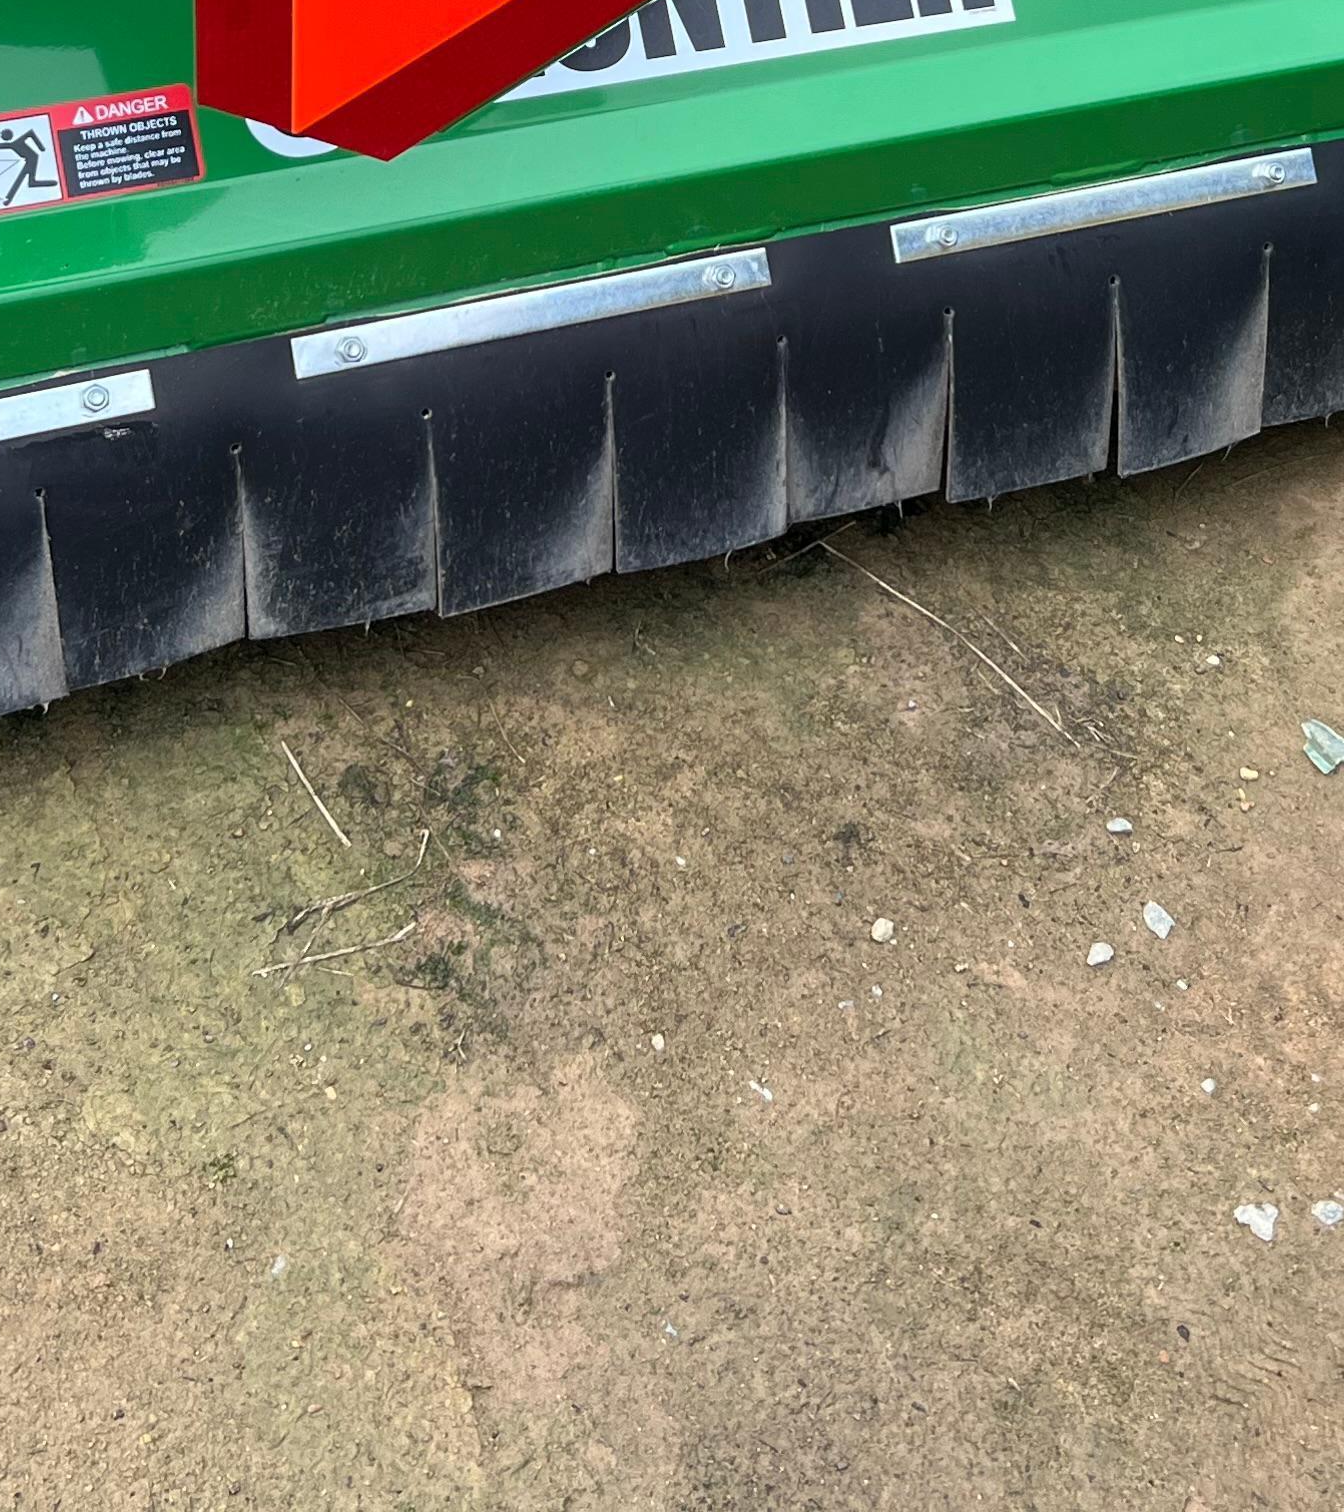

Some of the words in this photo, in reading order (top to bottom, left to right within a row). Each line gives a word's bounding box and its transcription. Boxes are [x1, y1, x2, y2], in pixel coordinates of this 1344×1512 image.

[95, 95, 168, 120] DANGER
[80, 124, 127, 140] THROWN
[129, 116, 177, 132] OBJECTS
[74, 142, 96, 153] Keep
[97, 141, 104, 149] a
[105, 138, 123, 148] safe
[124, 133, 160, 144] distance
[161, 129, 182, 138] from
[75, 153, 89, 161] the
[76, 159, 106, 170] Before
[144, 149, 165, 159] clear
[166, 145, 186, 155] area
[78, 170, 98, 179] from
[100, 164, 131, 176] objects
[133, 161, 150, 170] that
[151, 158, 169, 167] may
[79, 177, 111, 189] thrown
[111, 174, 123, 184] by
